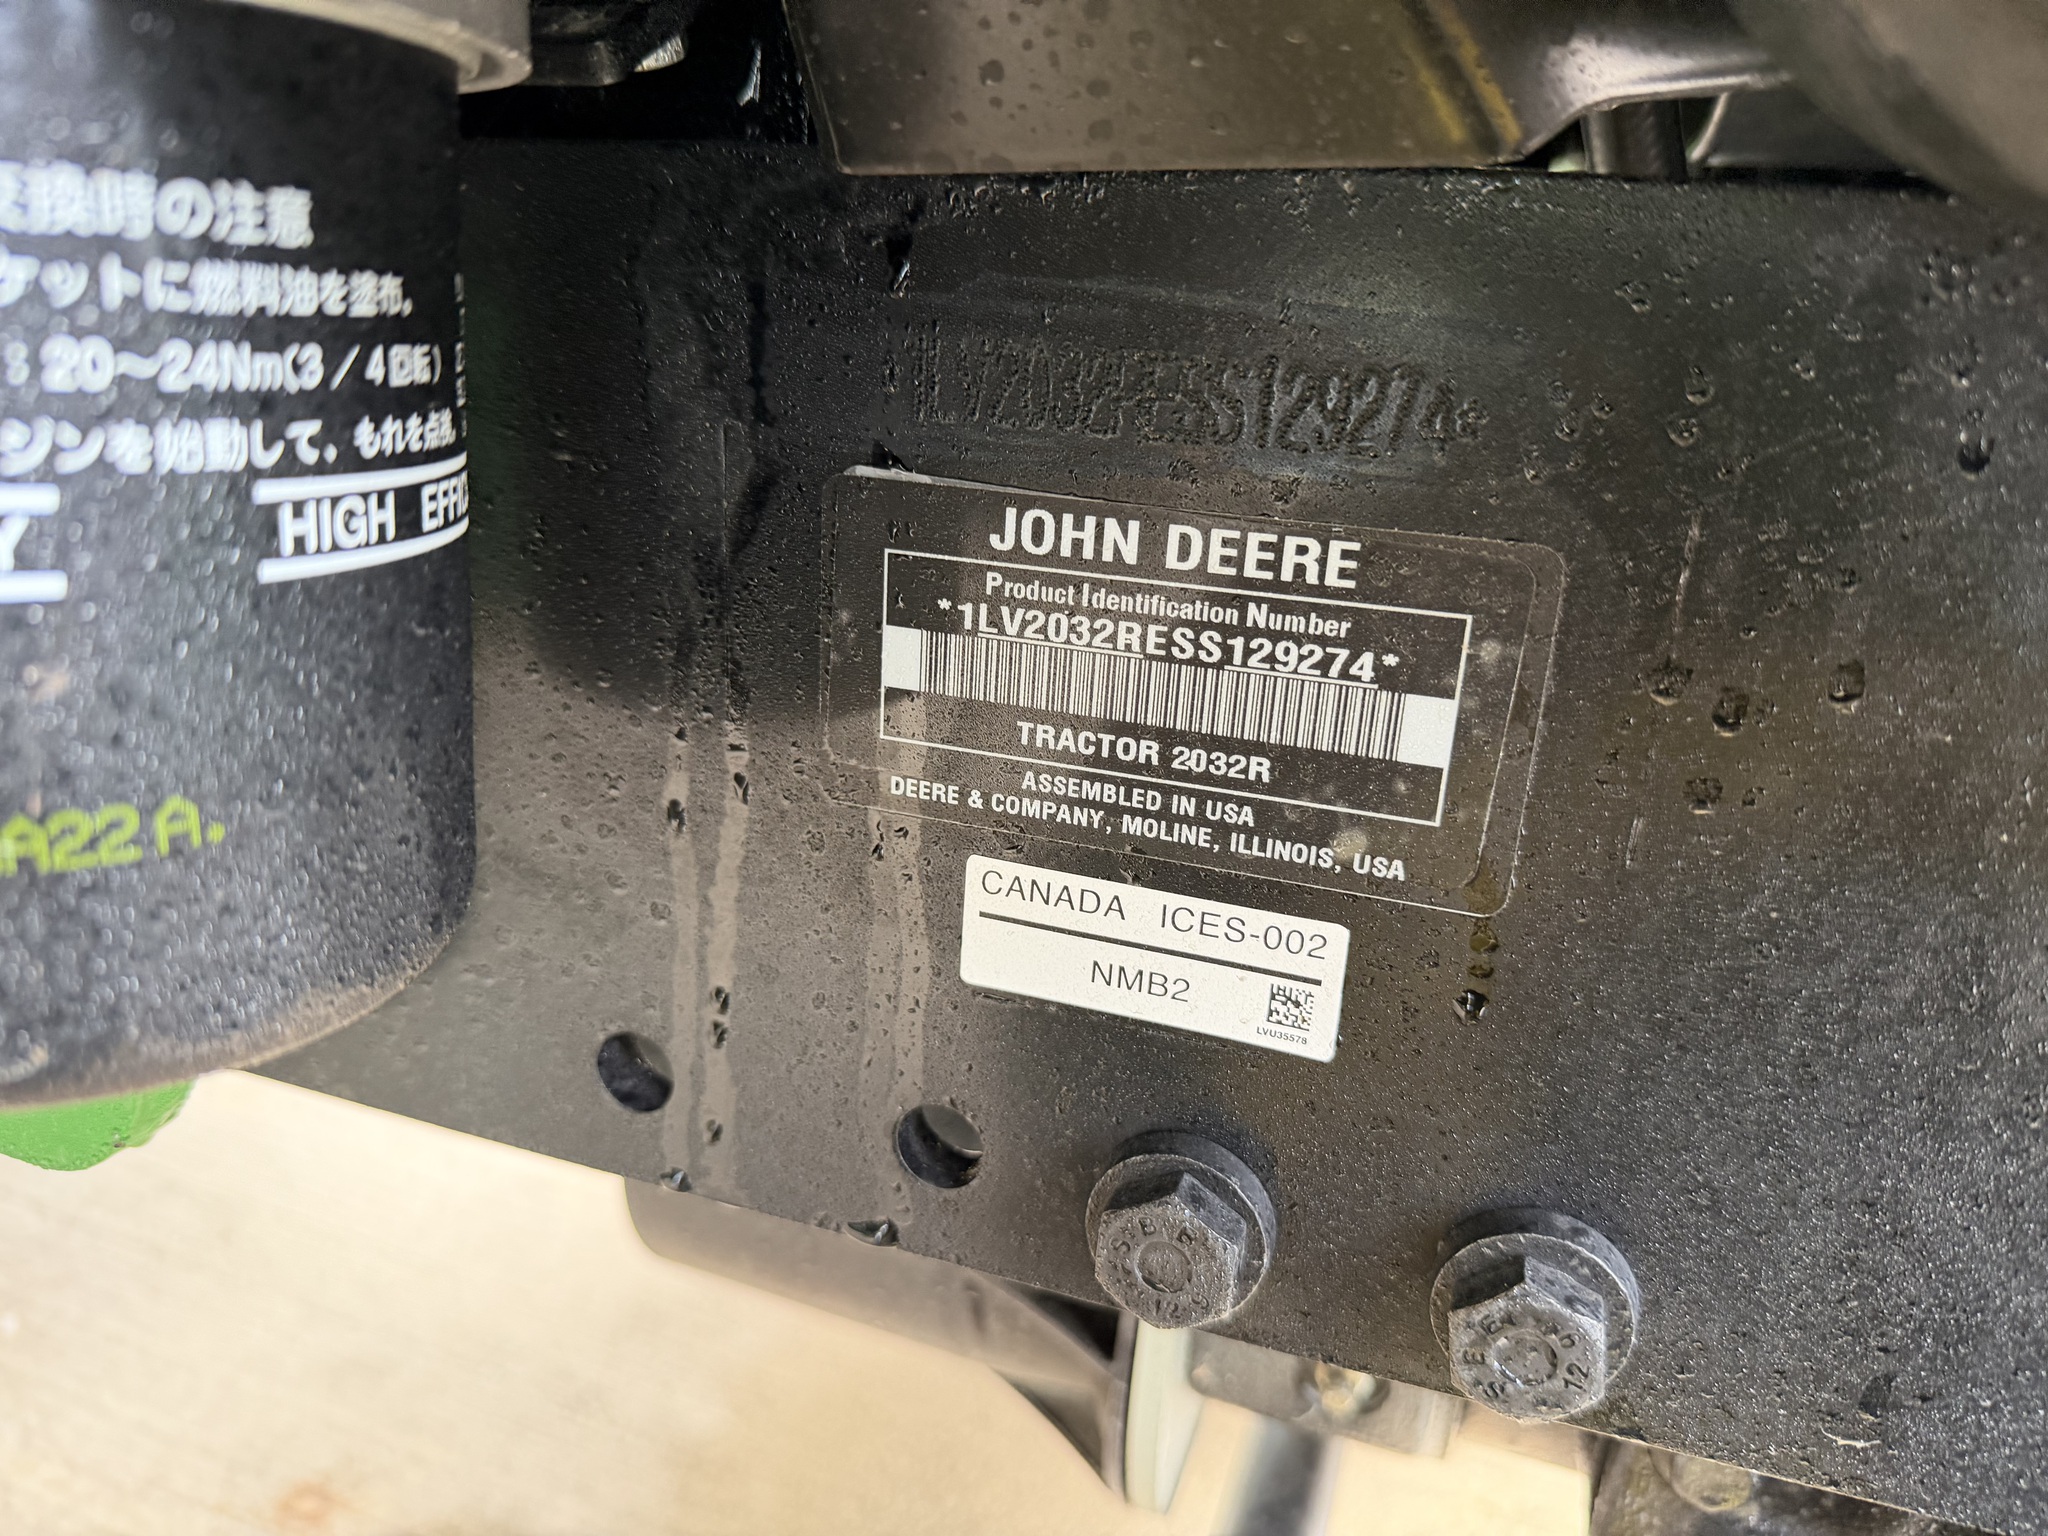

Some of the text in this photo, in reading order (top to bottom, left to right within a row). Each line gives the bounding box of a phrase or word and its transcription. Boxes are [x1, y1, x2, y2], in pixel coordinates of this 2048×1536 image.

[278, 490, 396, 557] HIGH
[990, 506, 1363, 590] JOHN DEERE
[985, 572, 1352, 639] Product Identification Number
[1017, 720, 1272, 783] TRACTOR 2032R
[890, 774, 1406, 882] DEERE & COMPANY, MOLINE, ILLINOIS, USA
[1021, 770, 1255, 827] ASSEMBLED IN USA
[981, 869, 1328, 960] CANADA ICES-002
[1091, 960, 1190, 1003] NMB2
